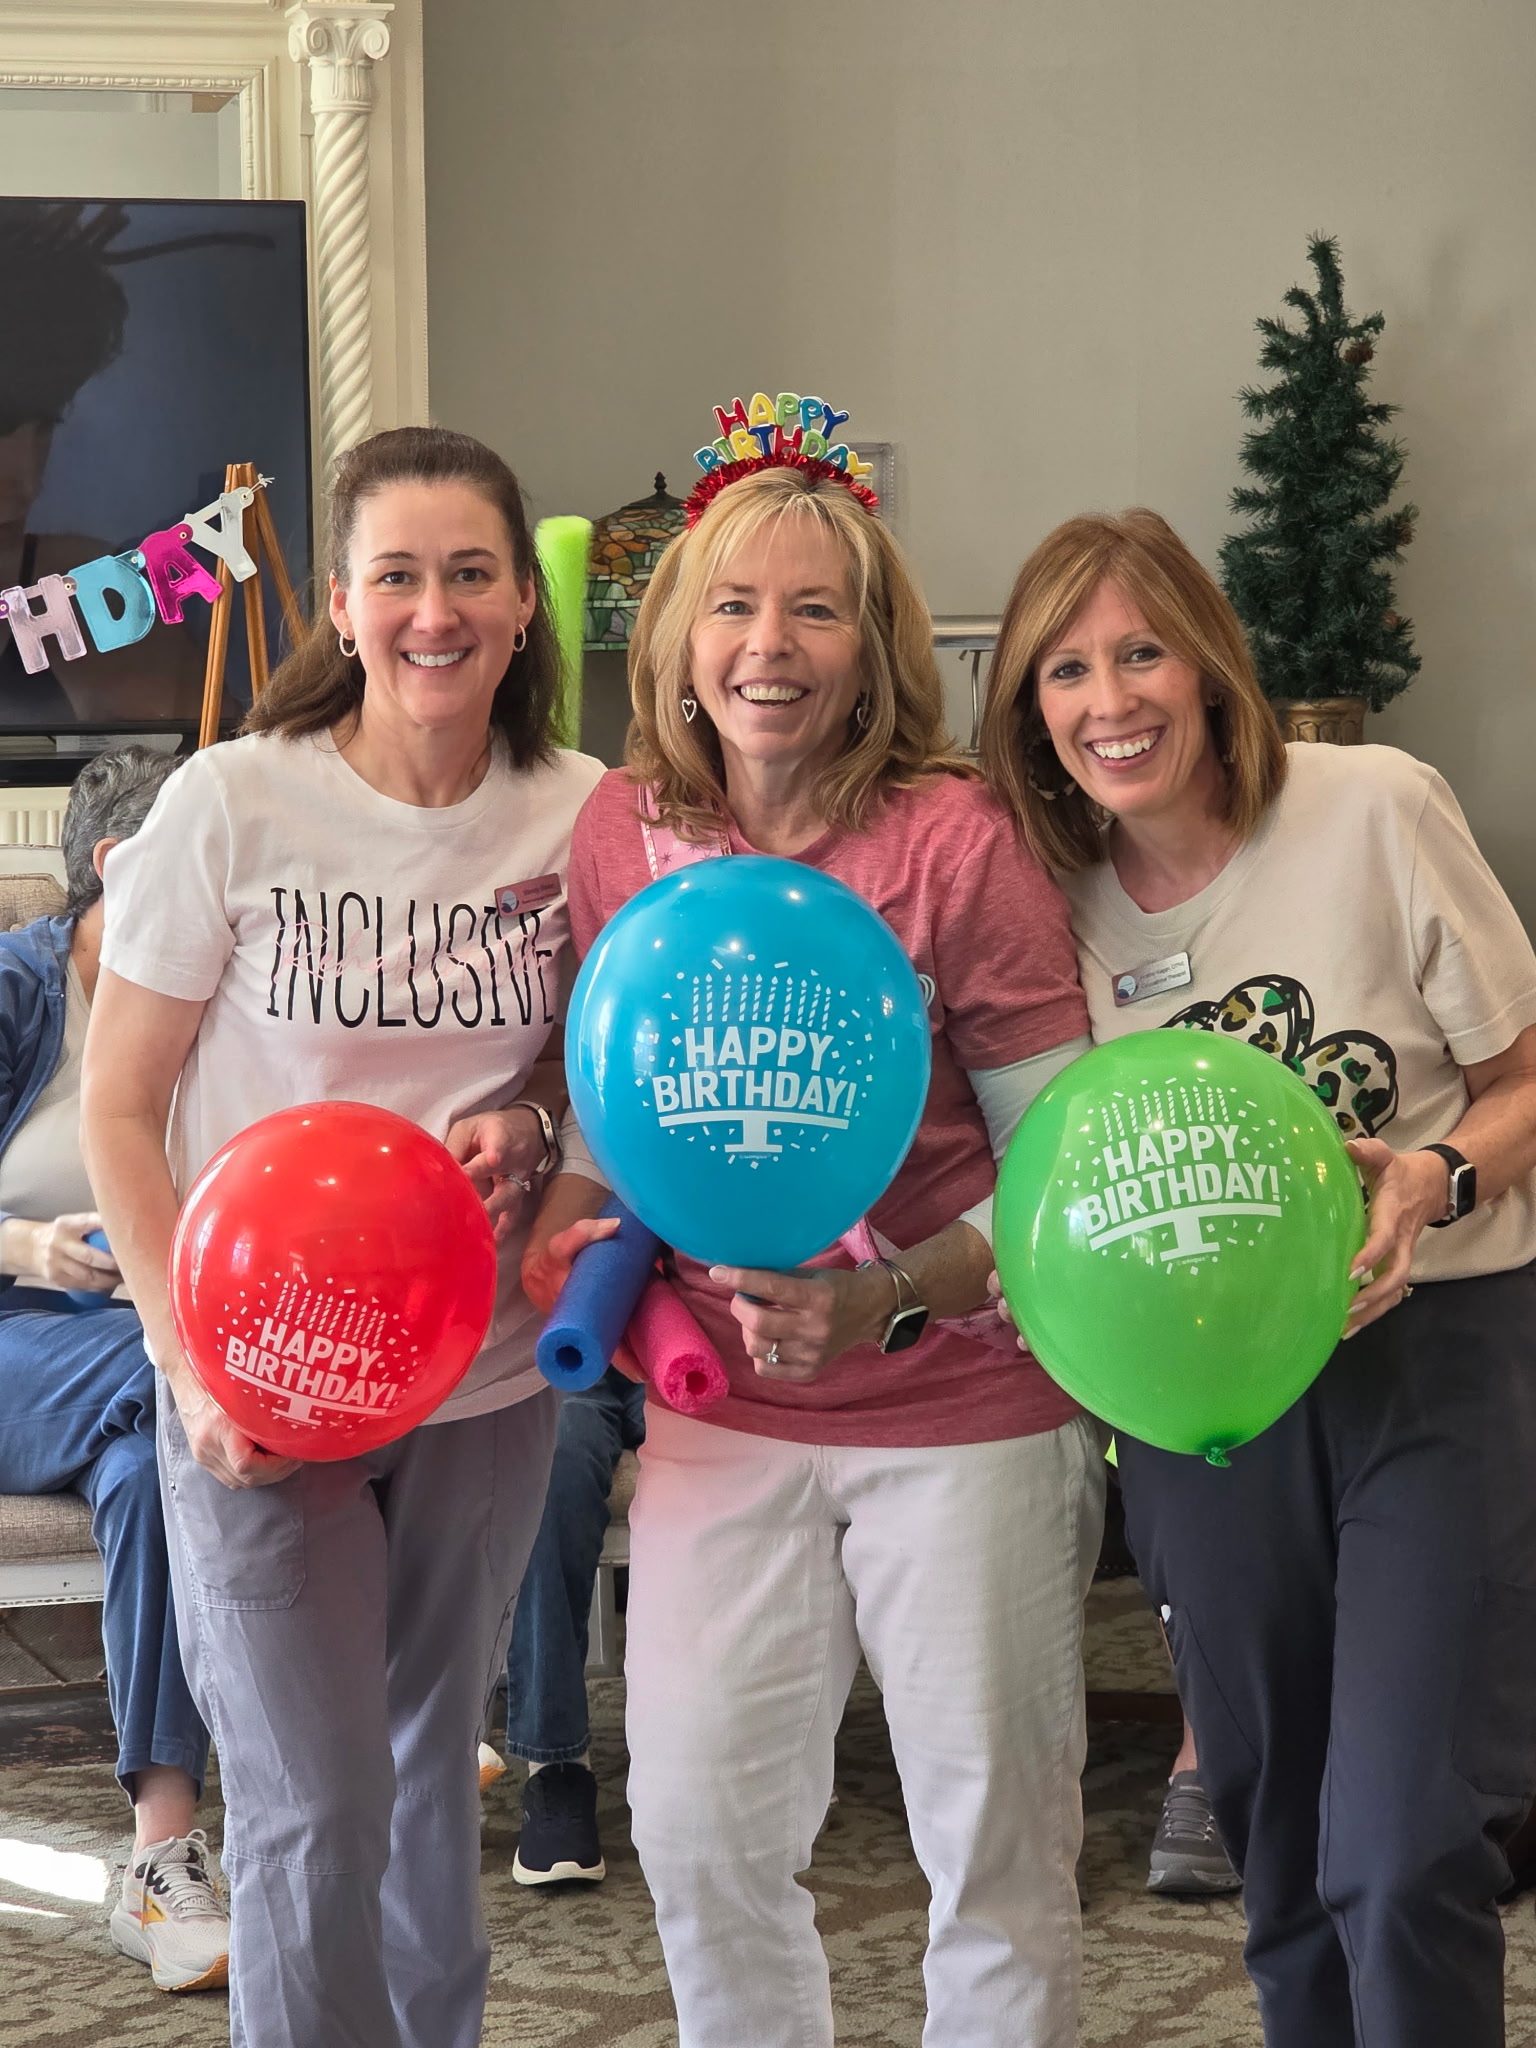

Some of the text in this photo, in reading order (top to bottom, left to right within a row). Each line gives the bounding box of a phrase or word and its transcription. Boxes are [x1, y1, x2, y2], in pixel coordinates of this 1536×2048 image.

[713, 392, 850, 440] HAPPY
[693, 424, 874, 476] BIRTHDAY
[266, 886, 555, 1029] INCLUSIVE
[684, 1026, 834, 1072] HAPPY
[652, 1069, 857, 1117] BIRTHDAY!
[1102, 1124, 1240, 1182] HAPPY
[1079, 1162, 1281, 1237] BIRTHDAY!
[225, 1335, 399, 1408] BIRTHDAY!
[258, 1316, 384, 1378] HAPPY
